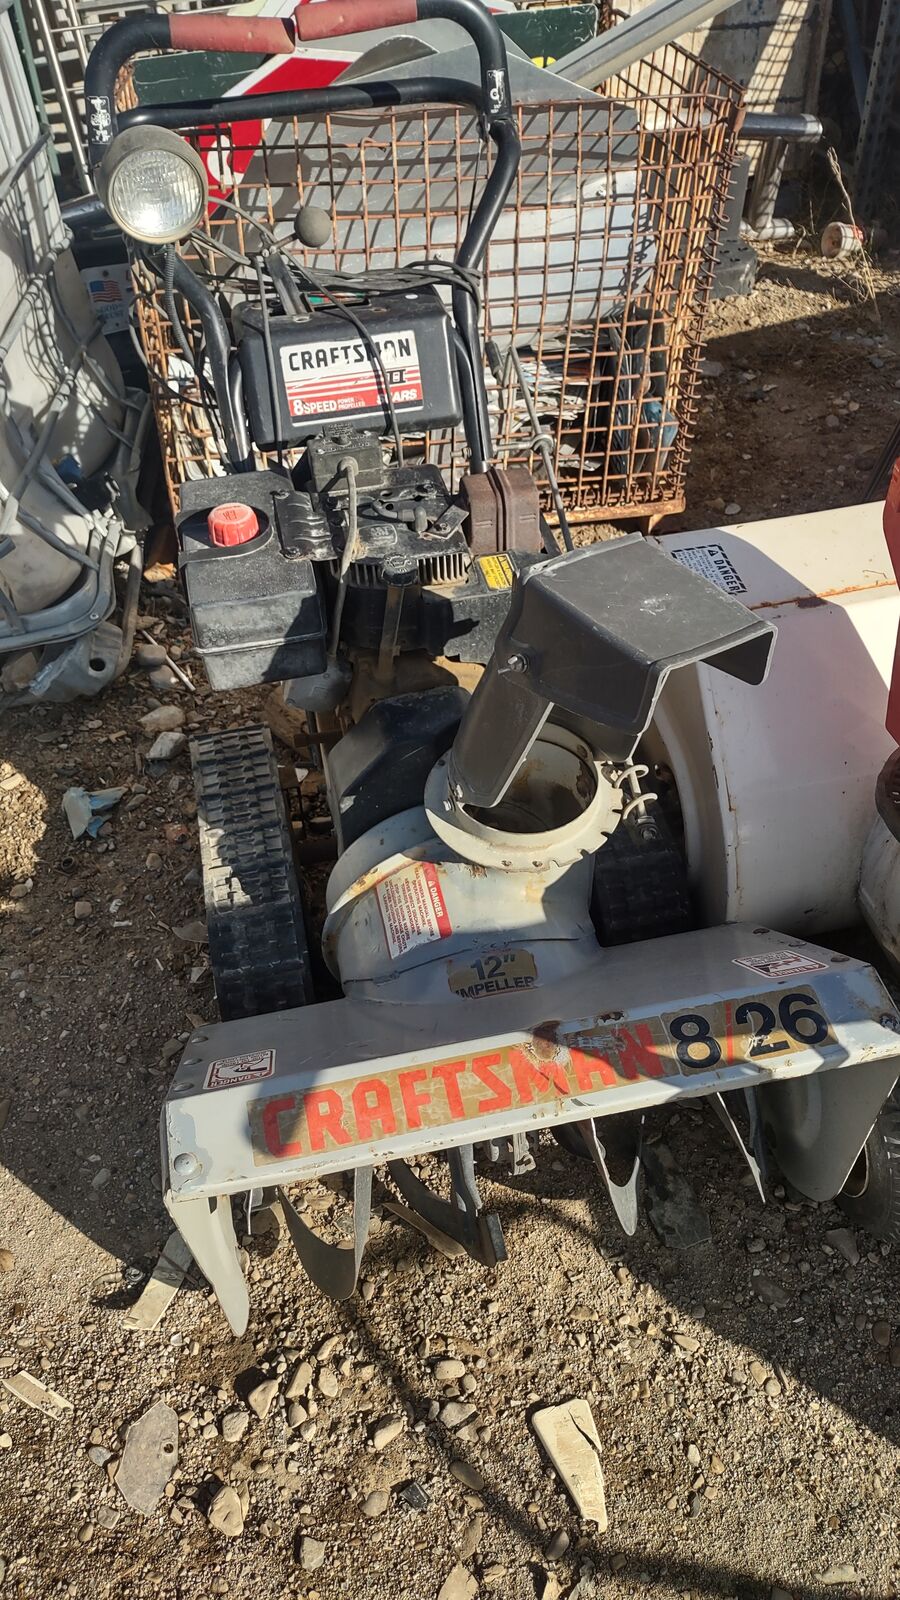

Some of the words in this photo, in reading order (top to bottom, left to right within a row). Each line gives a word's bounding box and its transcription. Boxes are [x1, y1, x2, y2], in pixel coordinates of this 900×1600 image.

[713, 559, 740, 592] DANGER
[412, 879, 421, 904] OPERATING
[430, 886, 443, 918] DANGER
[426, 918, 434, 937] BEFORE
[470, 954, 516, 980] 12"
[261, 1023, 666, 1159] CRAFTSMAN
